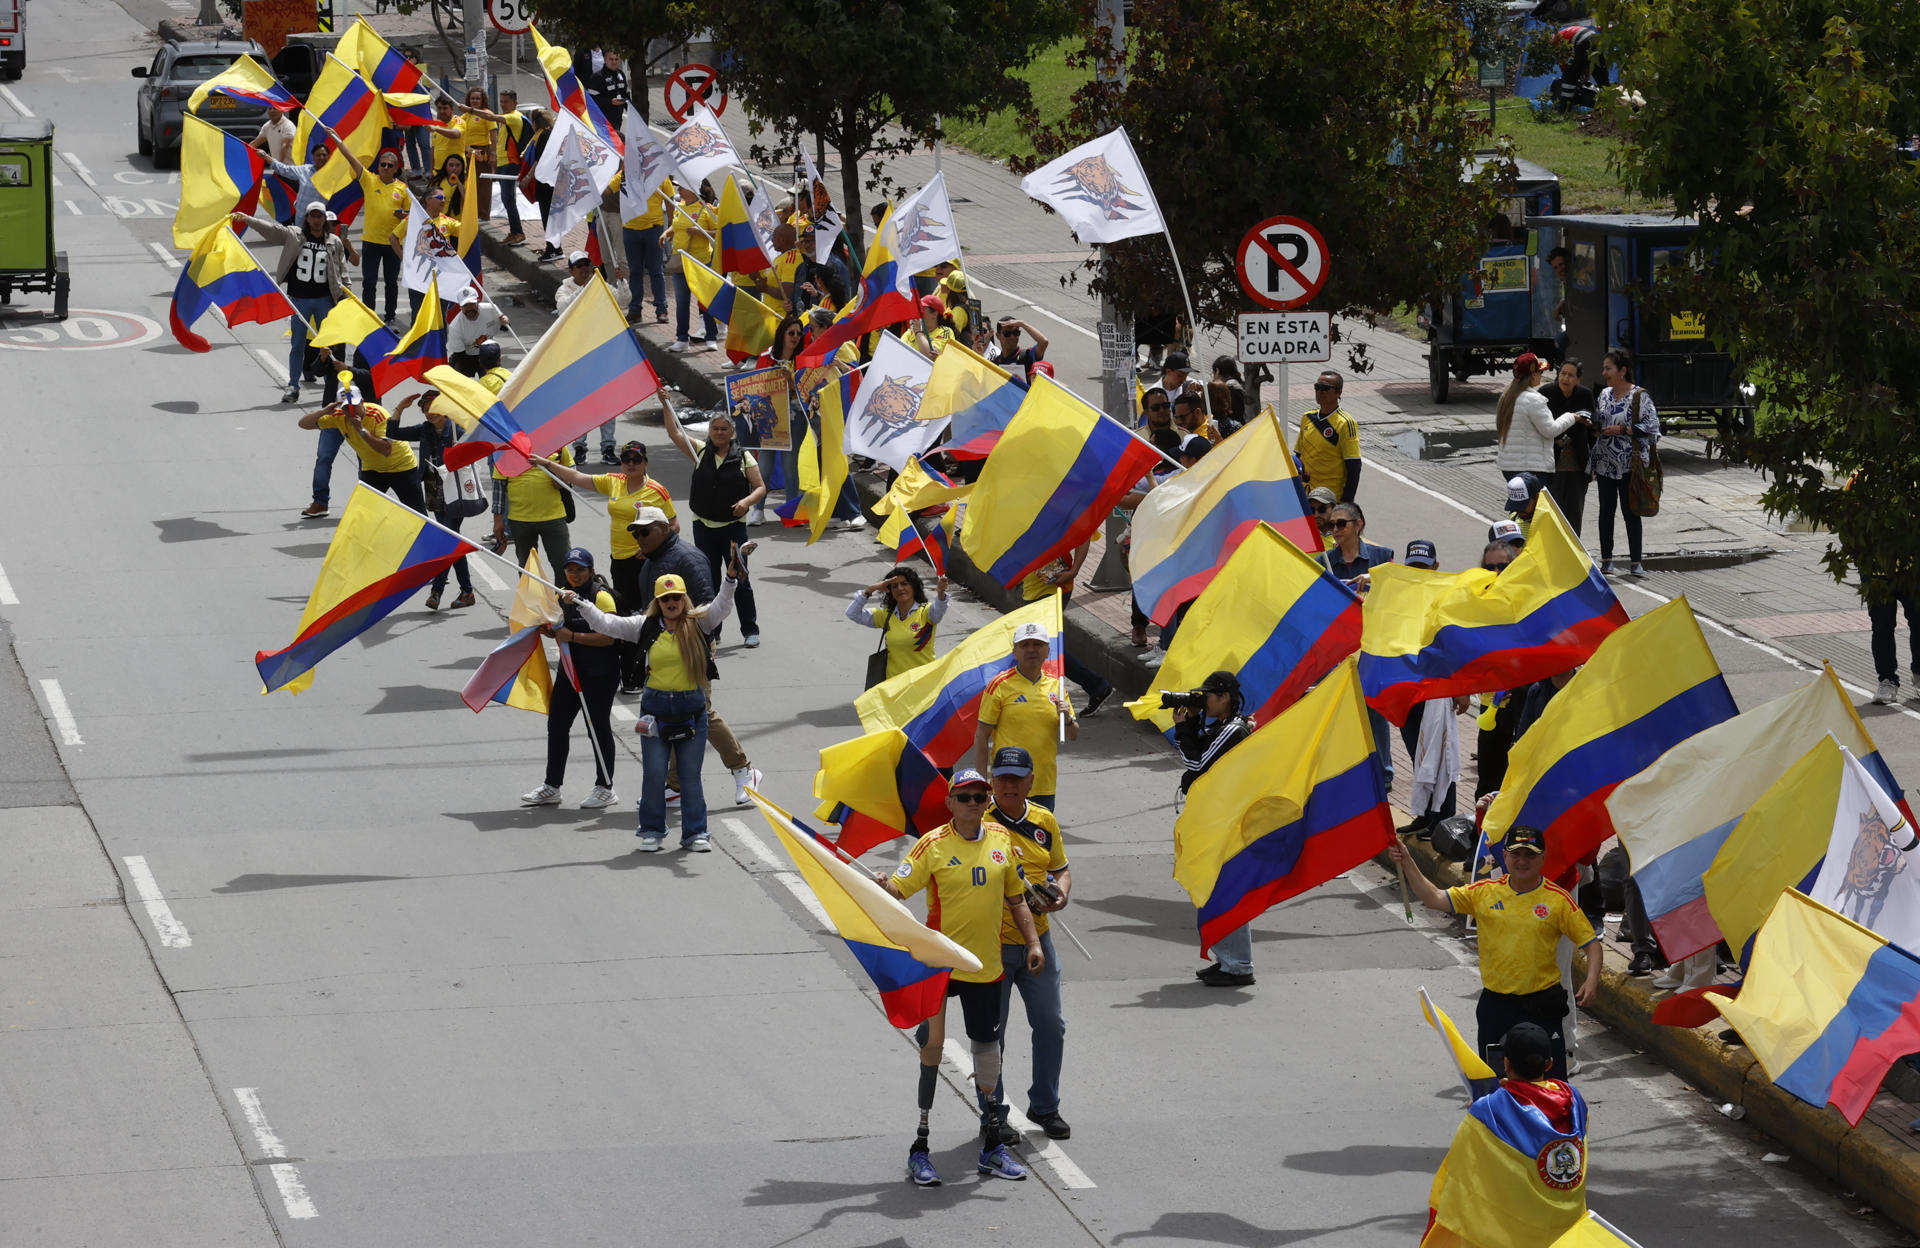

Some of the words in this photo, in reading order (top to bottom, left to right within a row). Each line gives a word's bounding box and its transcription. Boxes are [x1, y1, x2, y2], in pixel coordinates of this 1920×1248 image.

[296, 248, 328, 283] 96
[1267, 233, 1309, 292] P
[1246, 321, 1269, 334] EN
[1276, 320, 1320, 334] ESTA
[1246, 341, 1321, 355] CUADRA
[972, 867, 987, 886] 10
